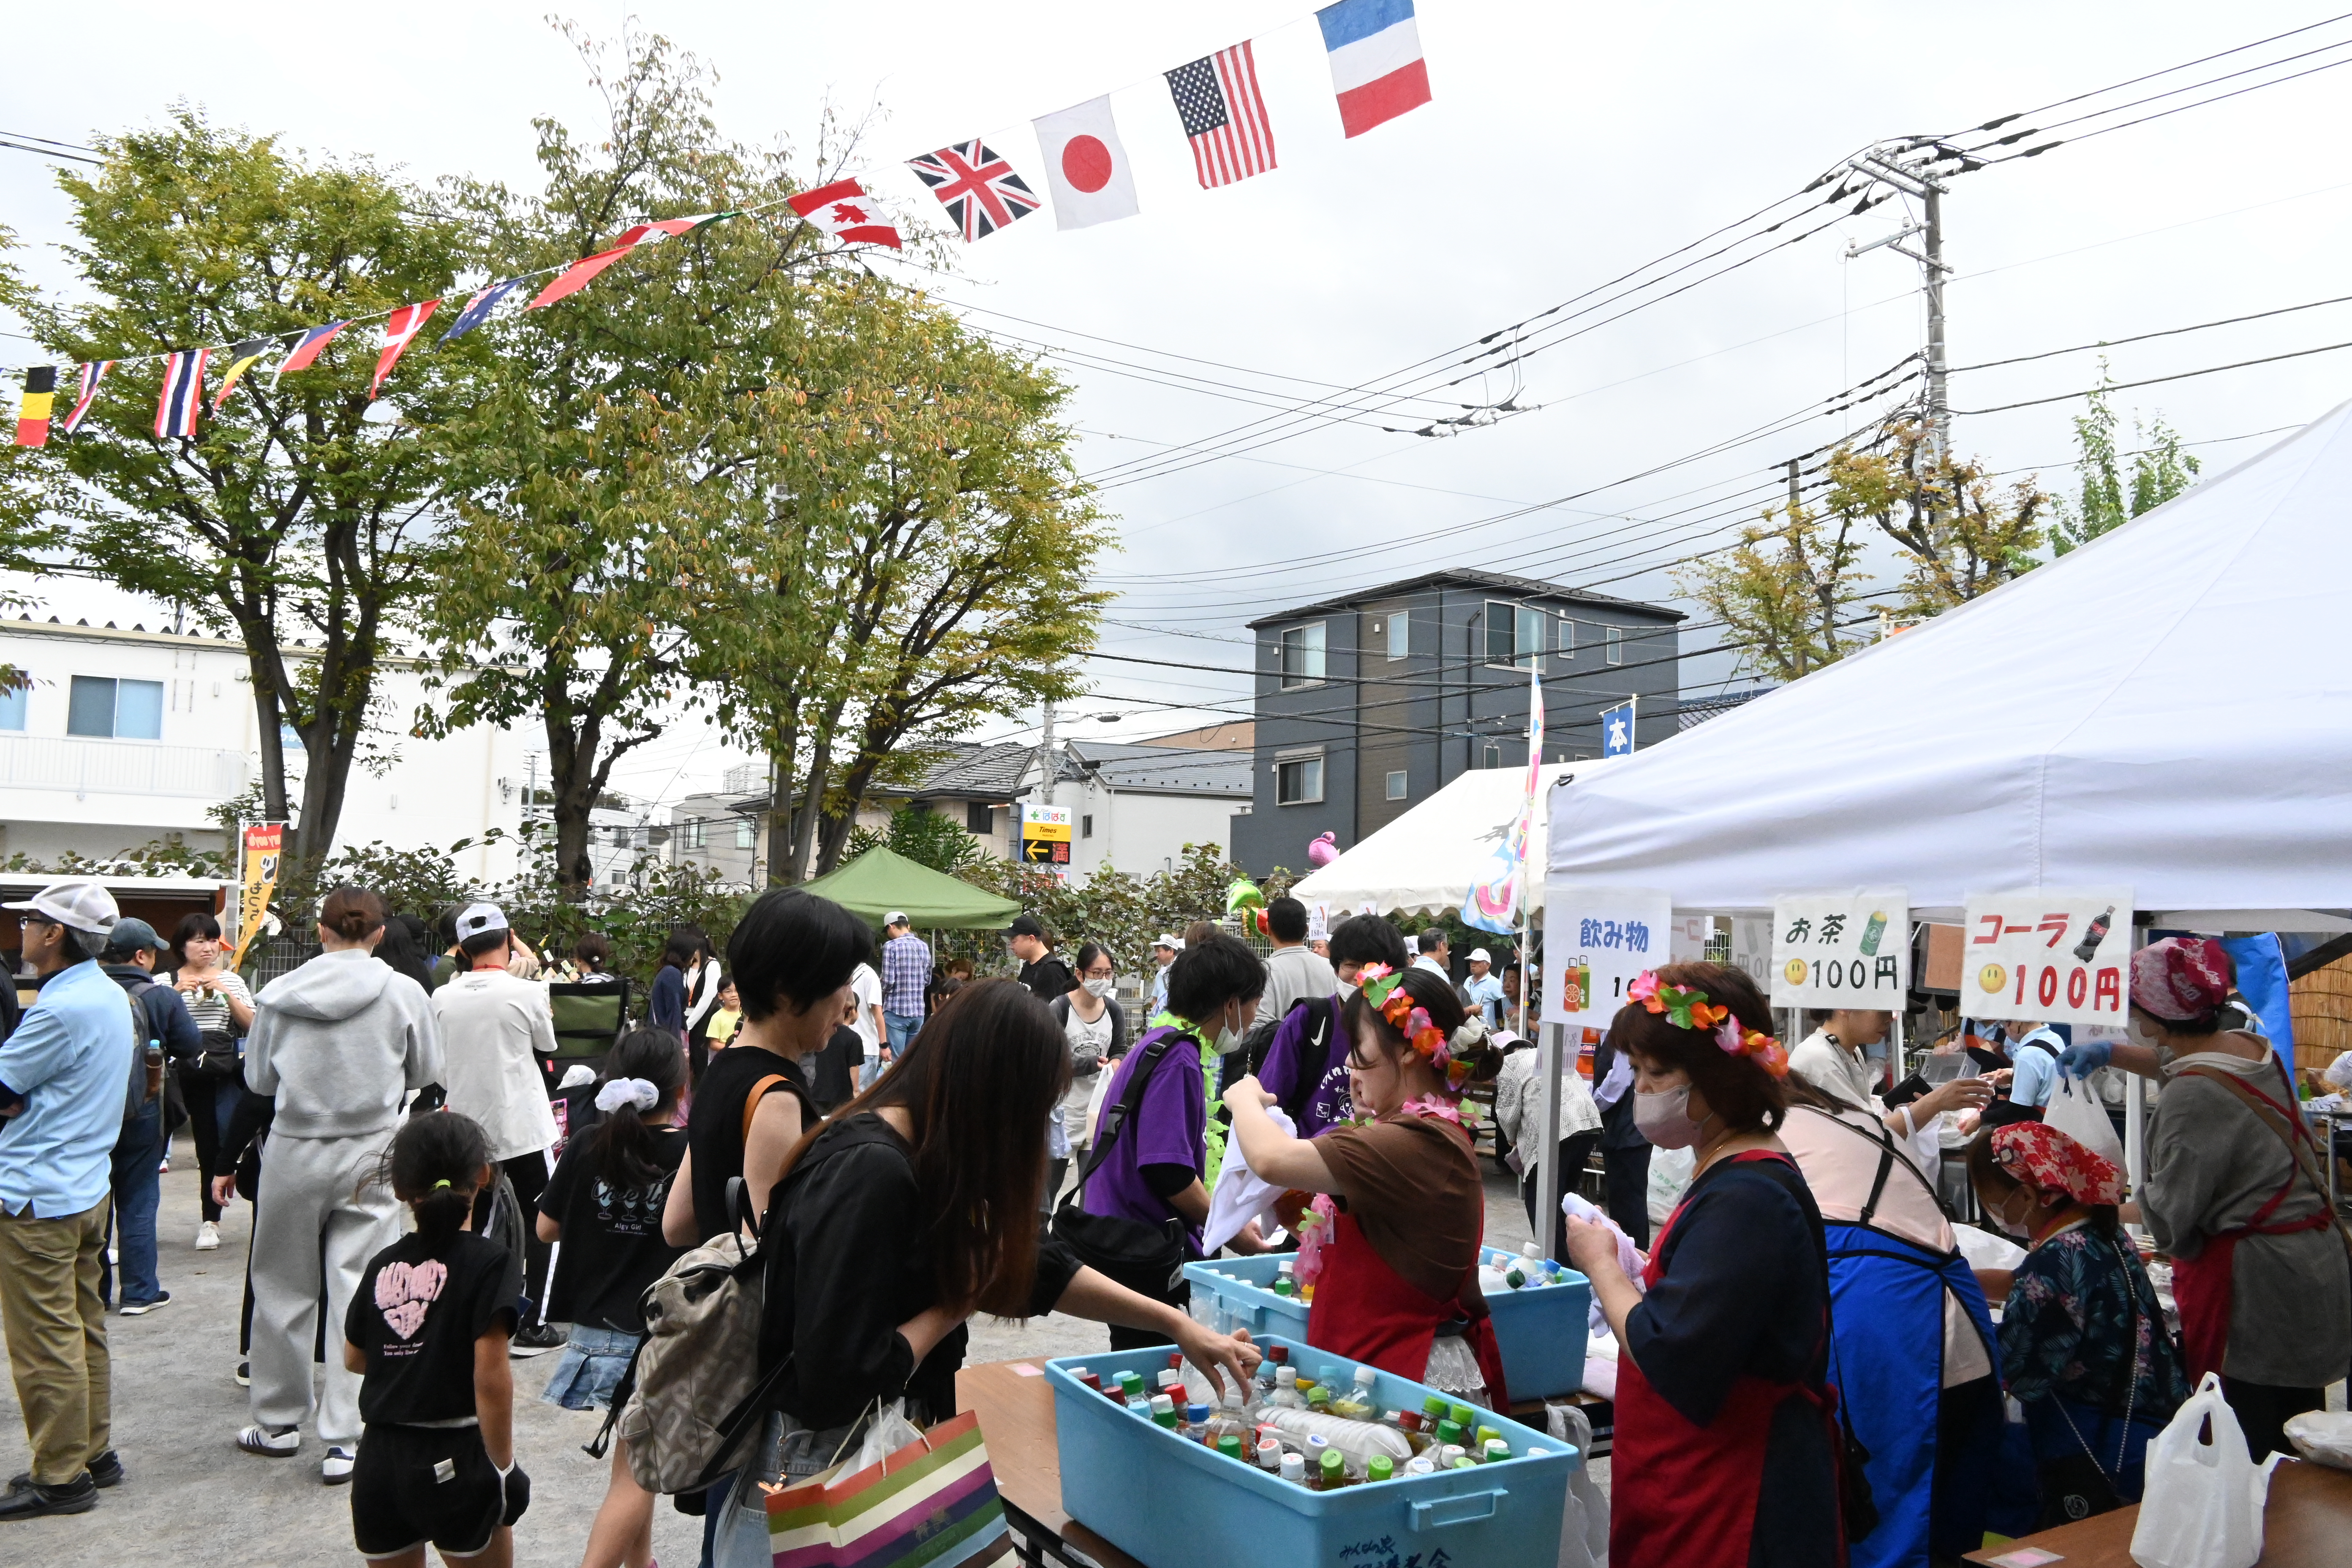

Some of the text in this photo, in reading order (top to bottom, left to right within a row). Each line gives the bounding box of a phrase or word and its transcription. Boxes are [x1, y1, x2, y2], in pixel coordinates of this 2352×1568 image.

[1609, 718, 1627, 752] 本
[1052, 842, 1068, 862] 満
[1580, 918, 1649, 953] 飲み物
[1786, 914, 1847, 945] お茶
[1973, 913, 2069, 948] コーラ
[1812, 955, 1897, 990] 100円
[2015, 964, 2120, 1012] 100円
